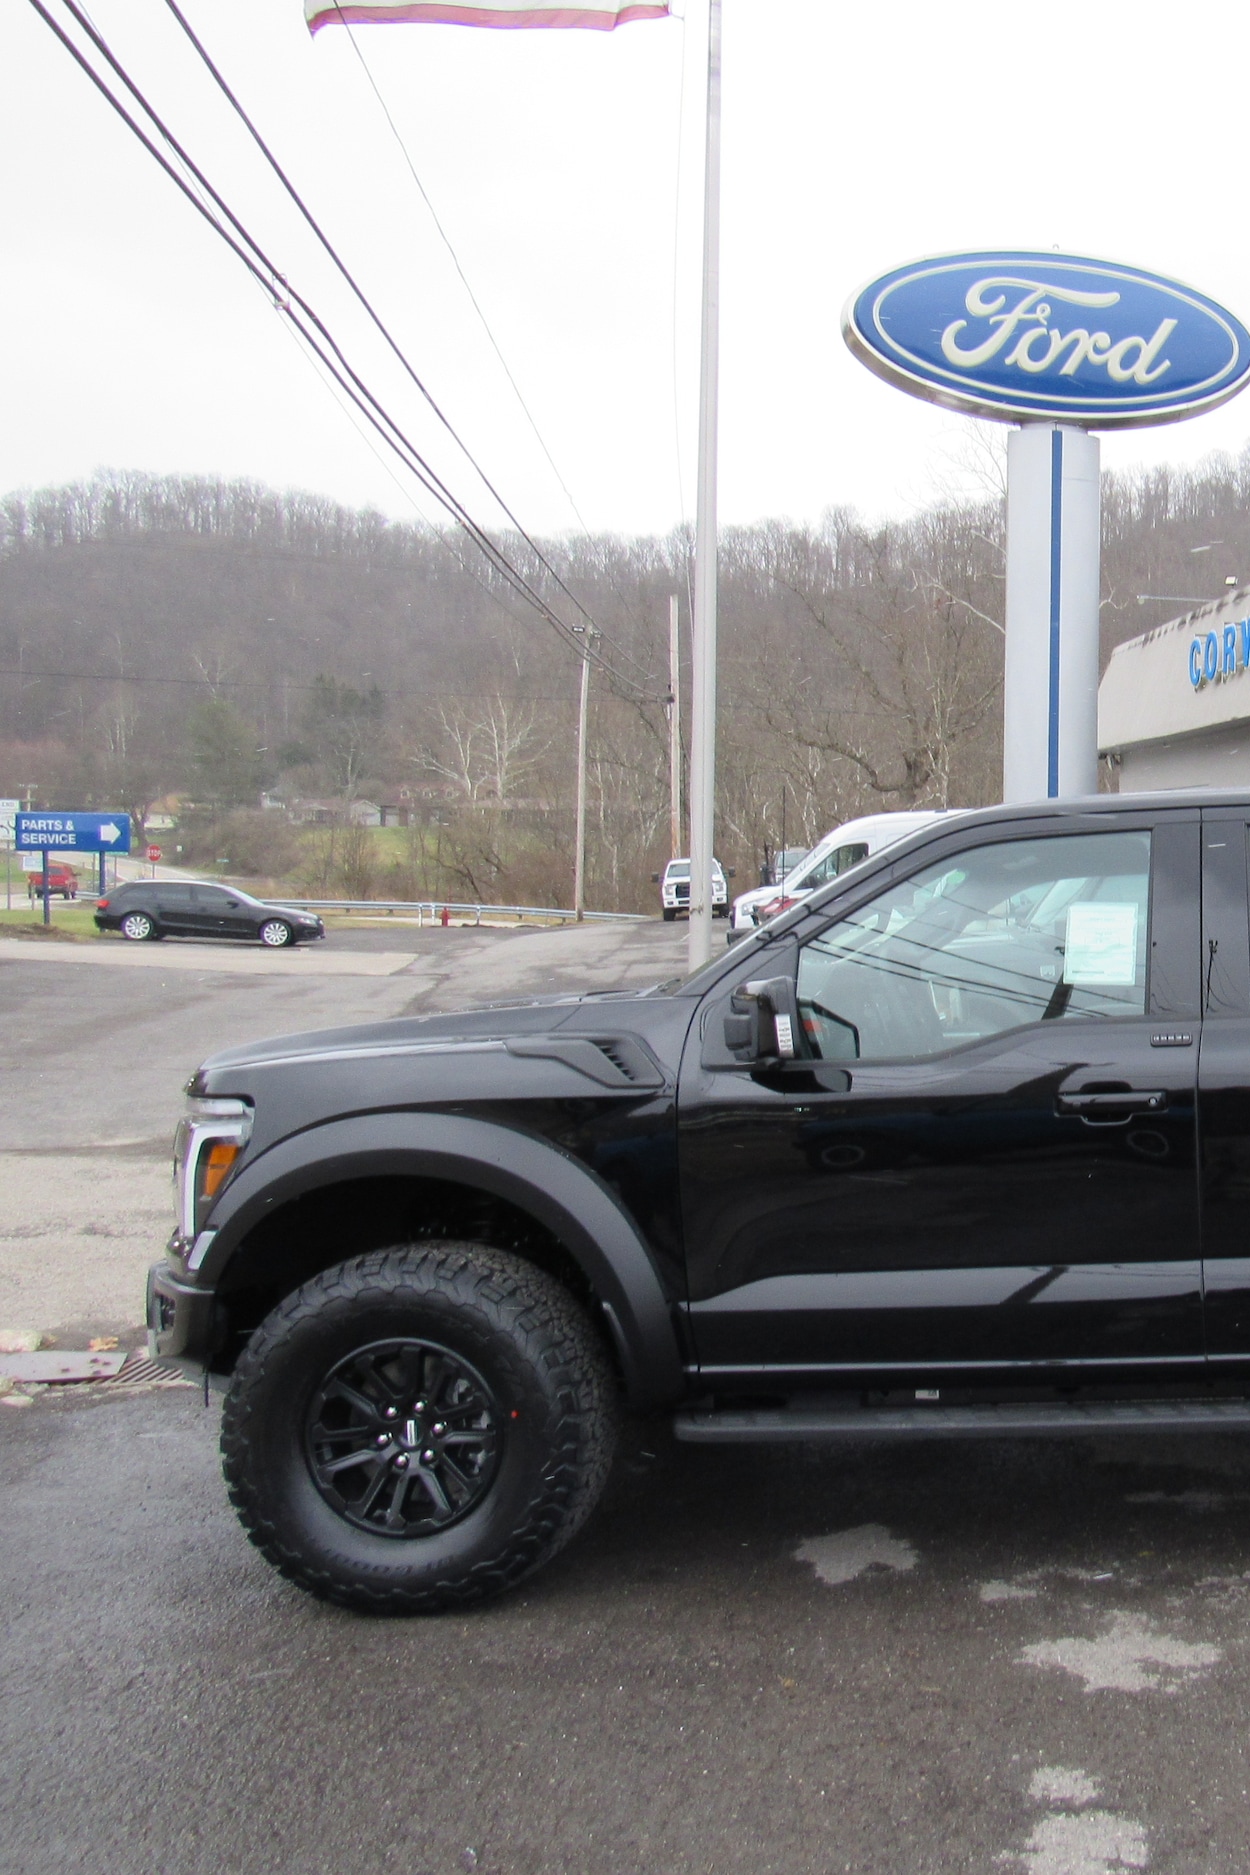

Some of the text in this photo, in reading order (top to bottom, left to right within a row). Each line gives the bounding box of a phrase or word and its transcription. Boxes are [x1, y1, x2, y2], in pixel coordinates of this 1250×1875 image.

[941, 276, 1178, 385] Ford
[21, 819, 75, 831] PARTS &
[21, 832, 77, 845] SERVICE
